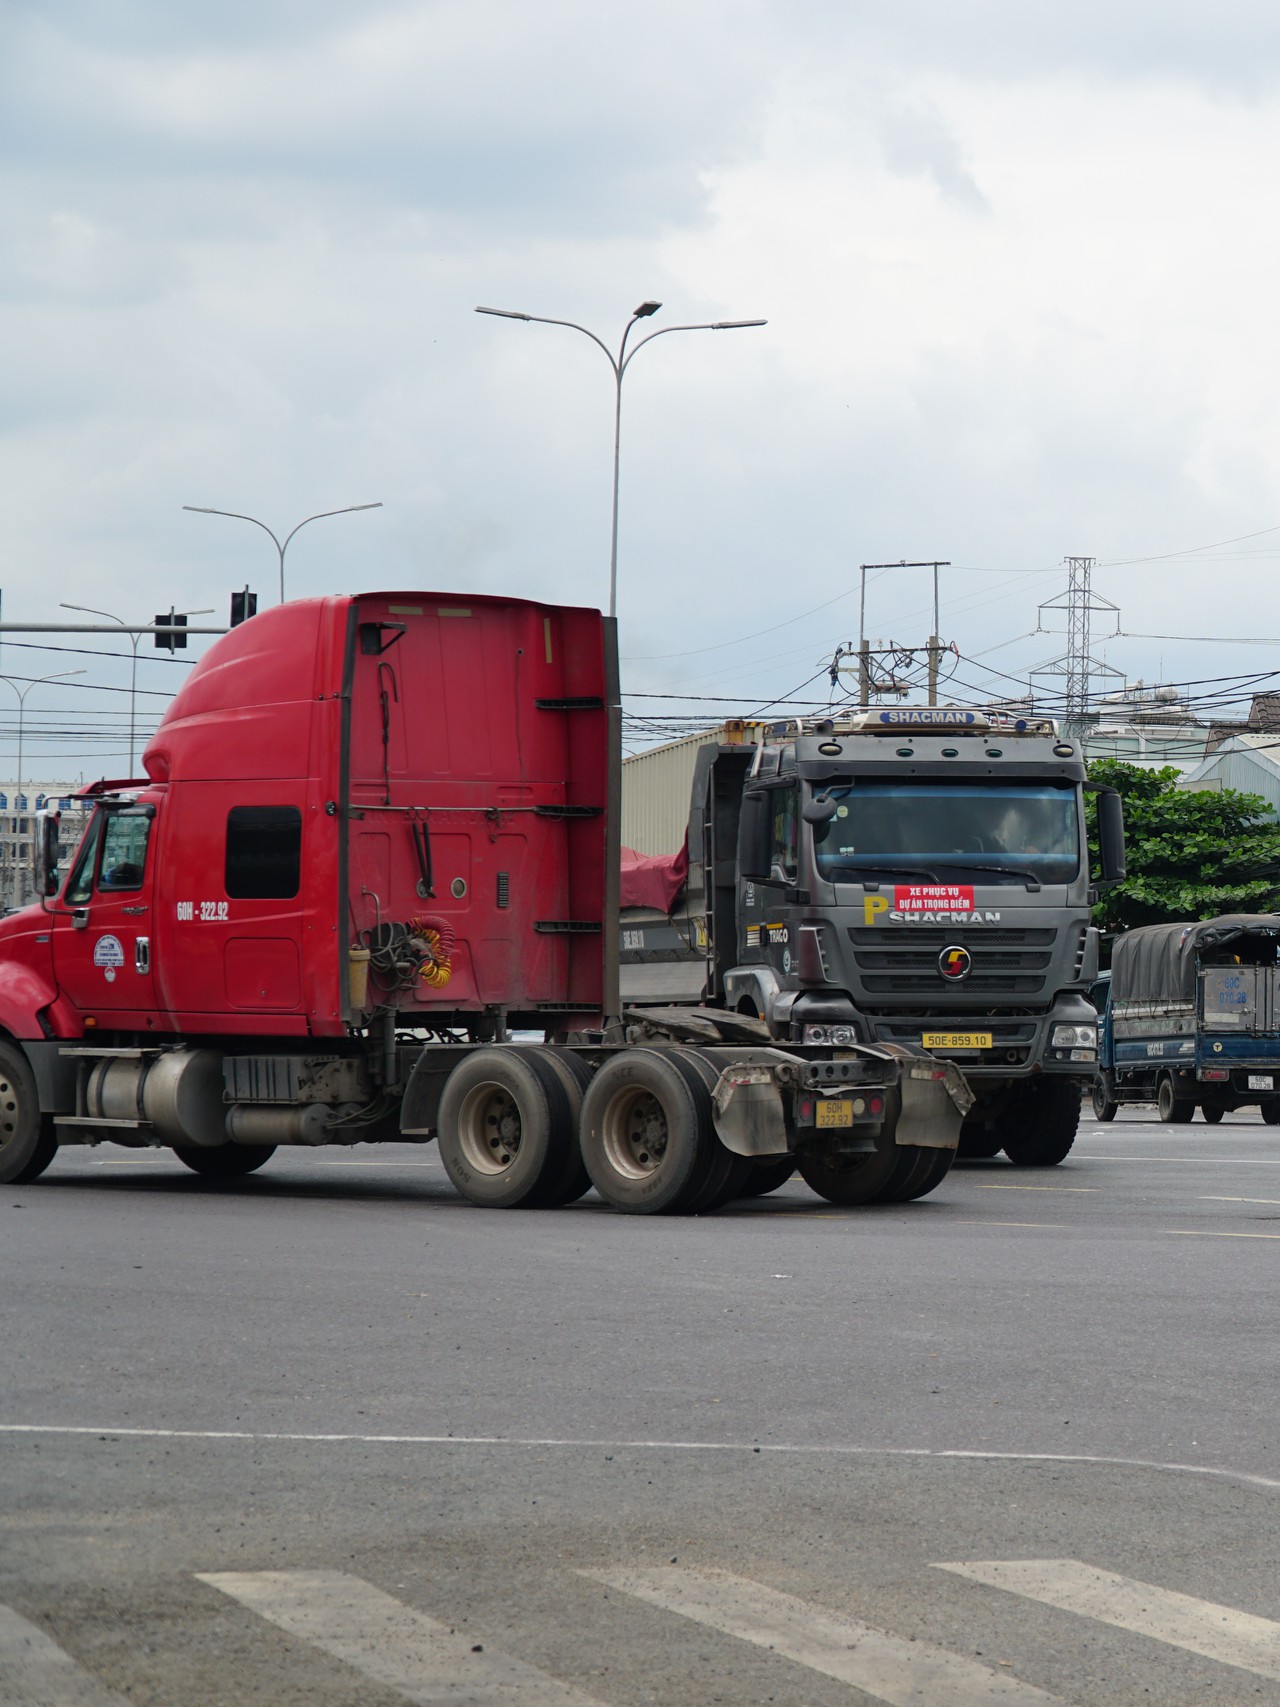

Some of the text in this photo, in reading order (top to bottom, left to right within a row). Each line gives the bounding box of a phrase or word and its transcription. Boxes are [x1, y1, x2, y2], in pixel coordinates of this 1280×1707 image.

[888, 712, 967, 723] SHACMAN
[910, 887, 959, 898] XE PHỤC VỤ
[899, 896, 970, 911] DỰ ÁN TRỌNG ĐIỂM
[177, 902, 229, 920] 60H 322.92
[864, 896, 889, 925] P
[889, 911, 1001, 925] SHACMAN
[928, 1035, 987, 1046] 50E-859.10
[826, 1102, 843, 1113] 60H
[820, 1114, 849, 1127] 322.92
